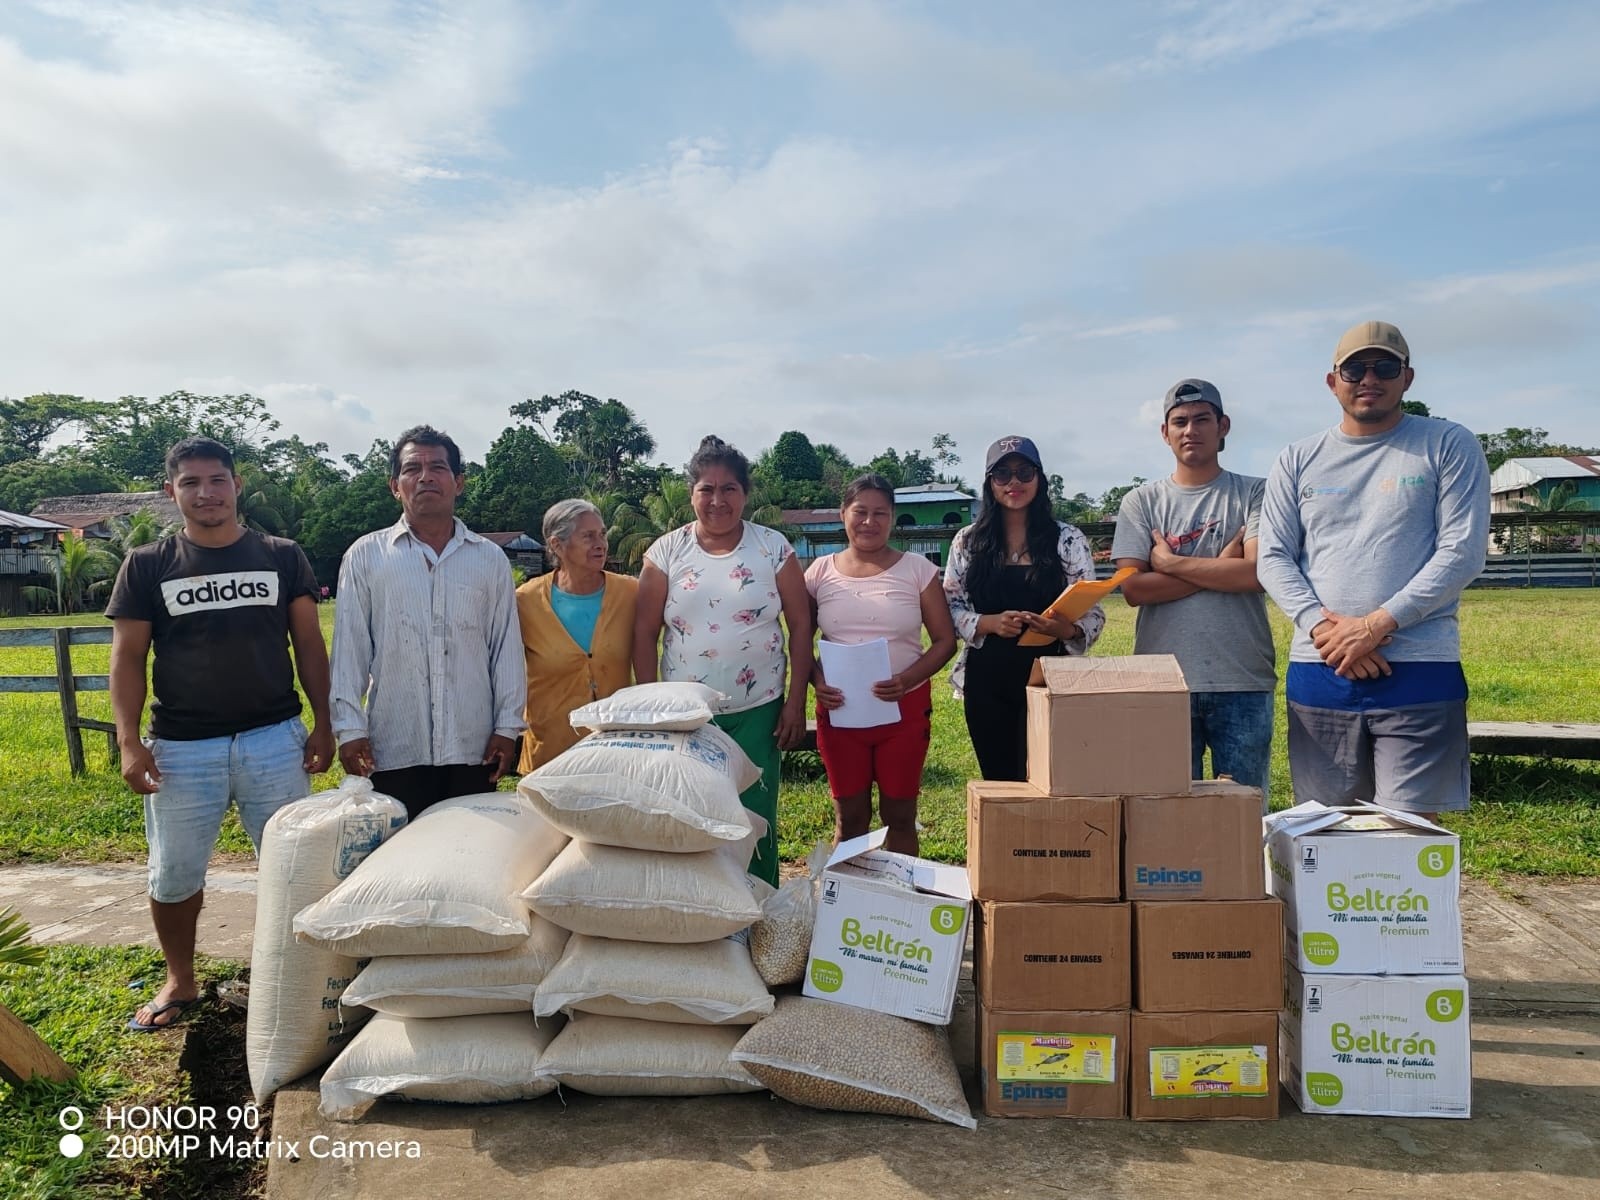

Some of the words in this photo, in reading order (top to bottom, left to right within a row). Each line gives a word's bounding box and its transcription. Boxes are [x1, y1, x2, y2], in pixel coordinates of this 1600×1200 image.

[176, 579, 270, 605] adidas
[1012, 848, 1047, 857] CONTIENE
[1048, 849, 1058, 858] 24
[1059, 849, 1091, 858] ENVASES
[1306, 848, 1313, 858] 7
[1428, 852, 1444, 870] B
[1136, 867, 1202, 886] Epinsa
[828, 880, 836, 890] 7
[1326, 882, 1429, 912] Beltrán
[940, 910, 954, 929] B
[1328, 912, 1348, 923] Mi
[1381, 911, 1394, 922] mi
[1396, 913, 1428, 925] familia
[1380, 925, 1430, 936] Premium
[841, 917, 933, 964] Beltrán
[838, 946, 858, 958] Mi
[886, 959, 899, 967] mi
[899, 959, 929, 974] familia
[1023, 954, 1058, 963] CONTIENE
[1059, 954, 1069, 963] 24
[1070, 954, 1103, 963] ENVASES
[1172, 951, 1205, 960] ENVASES
[1206, 951, 1216, 959] 24
[1217, 950, 1252, 959] CONTIENE
[883, 967, 928, 986] Premium
[1310, 987, 1318, 998] 7
[1436, 996, 1453, 1015] B
[1331, 1022, 1436, 1056] Beltrán
[1331, 1053, 1353, 1063] Mi
[1387, 1056, 1400, 1065] mi
[1401, 1057, 1435, 1068] familia
[1385, 1067, 1437, 1080] Premium
[1001, 1082, 1068, 1102] Epinsa
